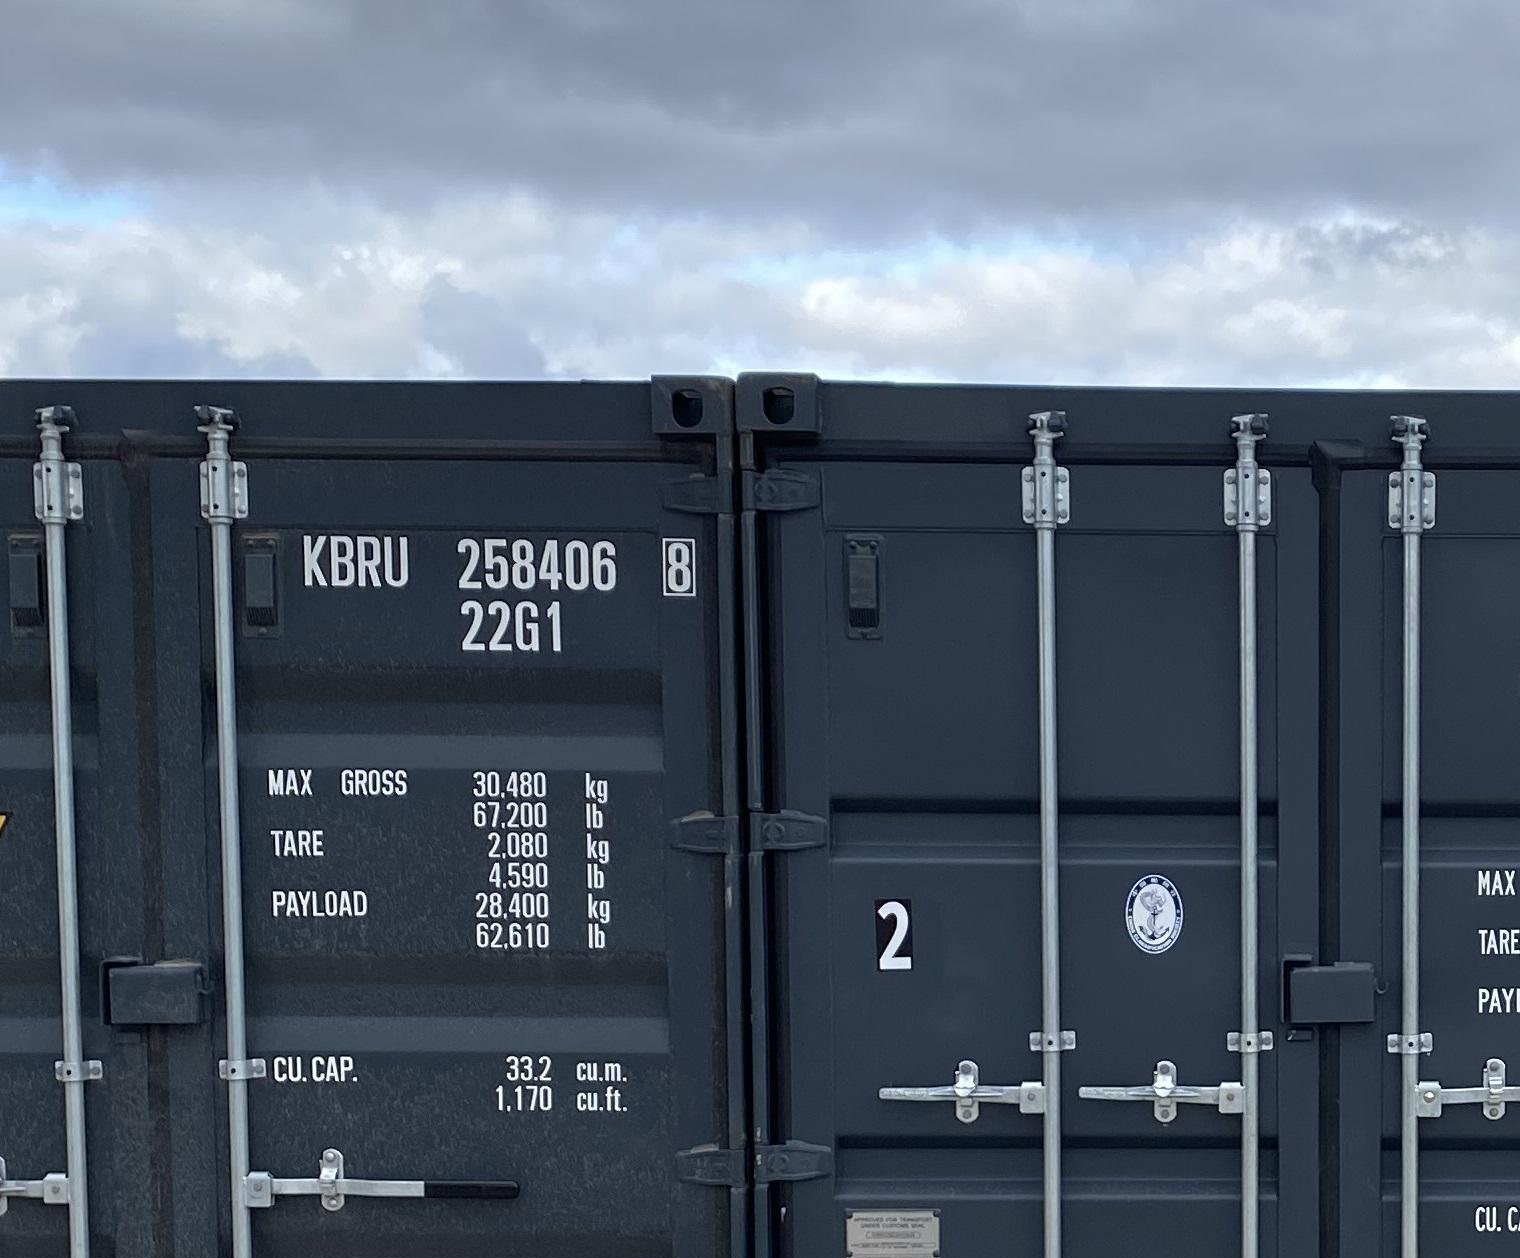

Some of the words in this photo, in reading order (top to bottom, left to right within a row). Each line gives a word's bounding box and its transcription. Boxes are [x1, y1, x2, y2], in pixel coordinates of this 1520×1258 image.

[303, 535, 409, 588] KBRU
[457, 538, 617, 592] 258406
[668, 542, 691, 592] 8
[460, 600, 562, 652] 22G1
[268, 769, 313, 796] MAX
[341, 769, 408, 796] GROSS
[585, 772, 608, 804] kg
[585, 802, 604, 829] lb
[270, 830, 324, 857] TARE
[586, 833, 610, 864] kg
[587, 863, 605, 889] lb
[1477, 870, 1516, 896] MAX
[272, 890, 368, 917] PAYLOAD
[587, 893, 610, 924] kg
[588, 923, 606, 949] lb
[877, 901, 912, 970] 2
[1478, 929, 1520, 955] TARE
[506, 1055, 552, 1082] 33.2
[576, 1062, 627, 1082] cu.m.
[576, 1085, 628, 1112] cu.ft.
